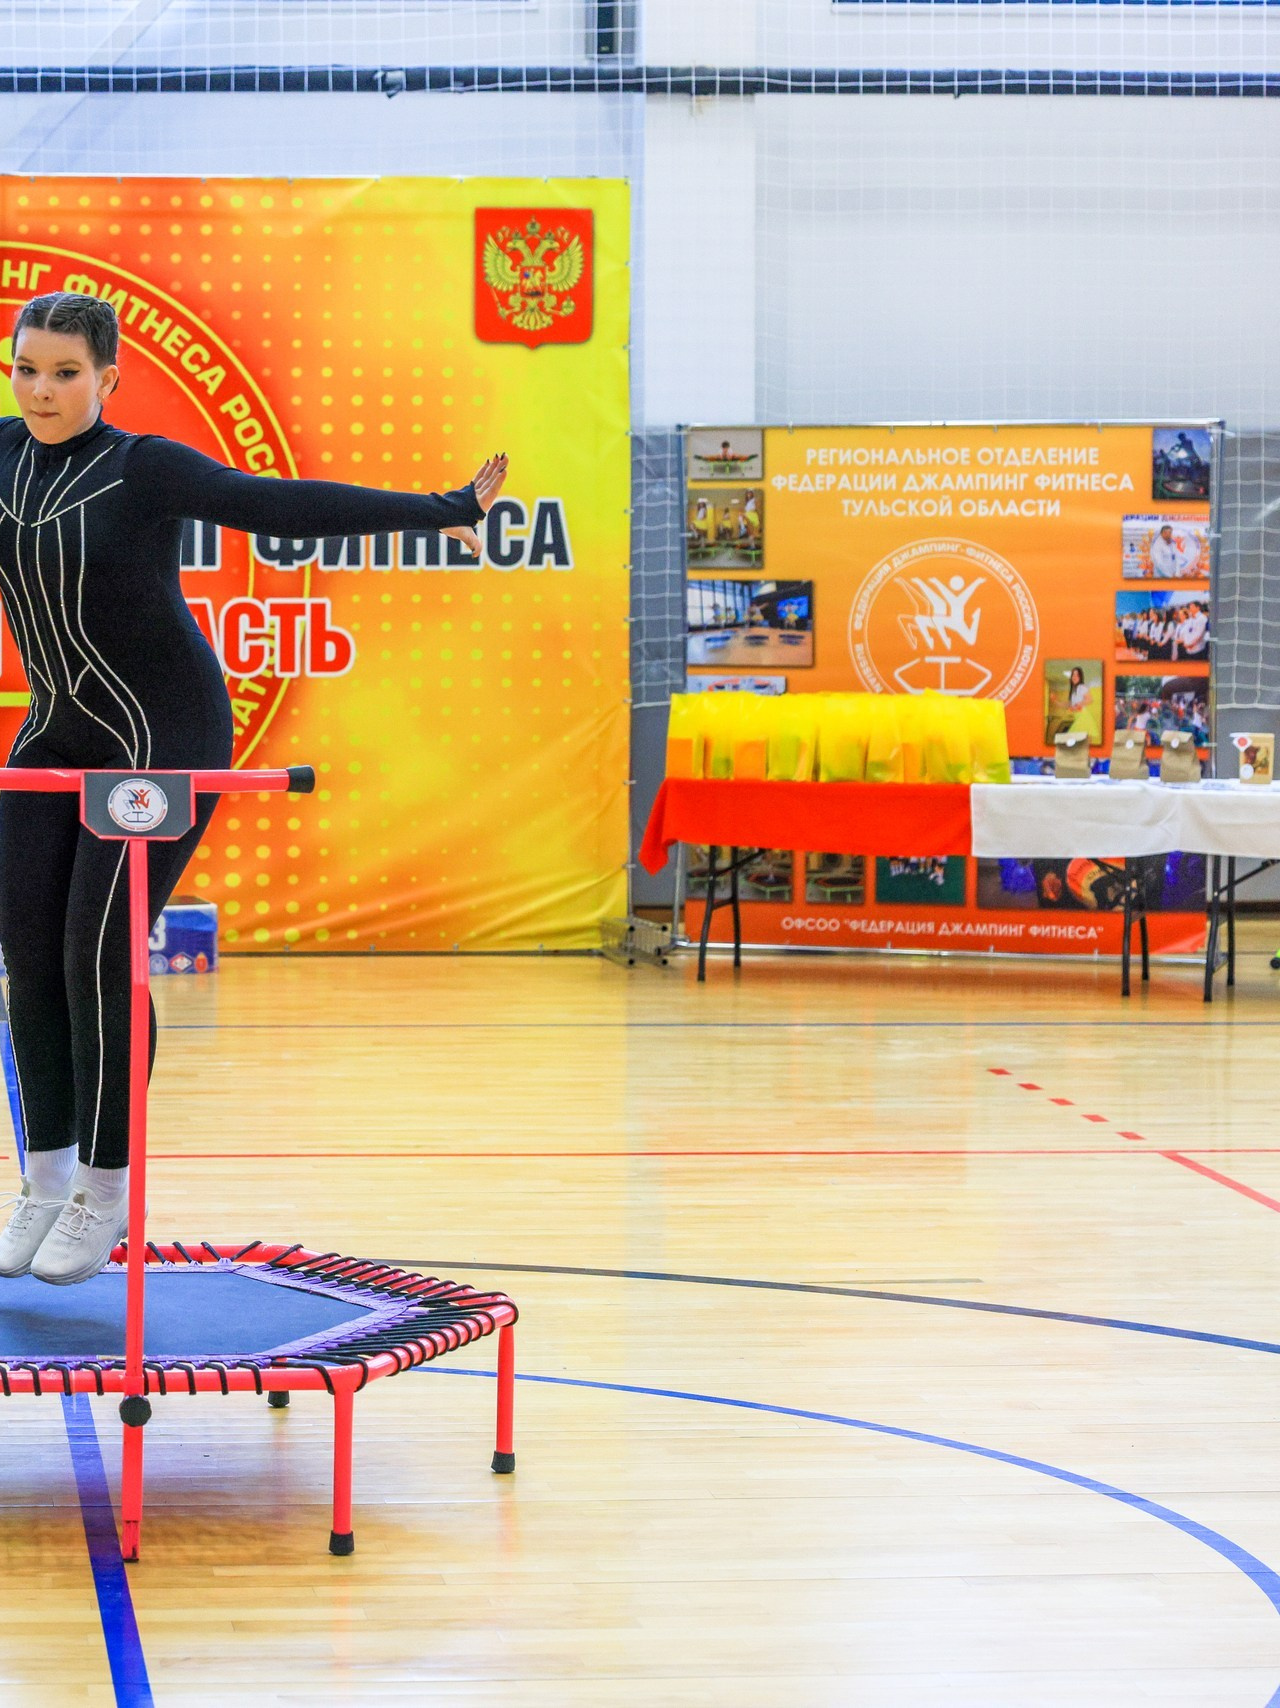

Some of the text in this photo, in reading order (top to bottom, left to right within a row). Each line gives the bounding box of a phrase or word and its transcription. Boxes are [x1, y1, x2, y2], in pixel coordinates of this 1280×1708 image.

[63, 274, 227, 396] ФИТНЕСА
[806, 447, 1100, 467] РЕГИОНАЛЬНОЕ ОТДЕЛЕНИЕ
[771, 473, 1134, 492] ФЕДЕРАЦИИ ДЖАМПИНГ ФИТНЕСА
[841, 495, 1061, 517] ТУЛЬСКОЙ ОБЛАСТИ
[854, 542, 1035, 631] ФЕДЕРАЦИЯ ДЖАМПИНГ ФИТНЕСА РОССИИ
[148, 914, 167, 951] 3
[781, 916, 1104, 939] ОФСОО "ФЕДЕРАЦИЯ ДЖАМПИНГ ФИТНЕСА"
